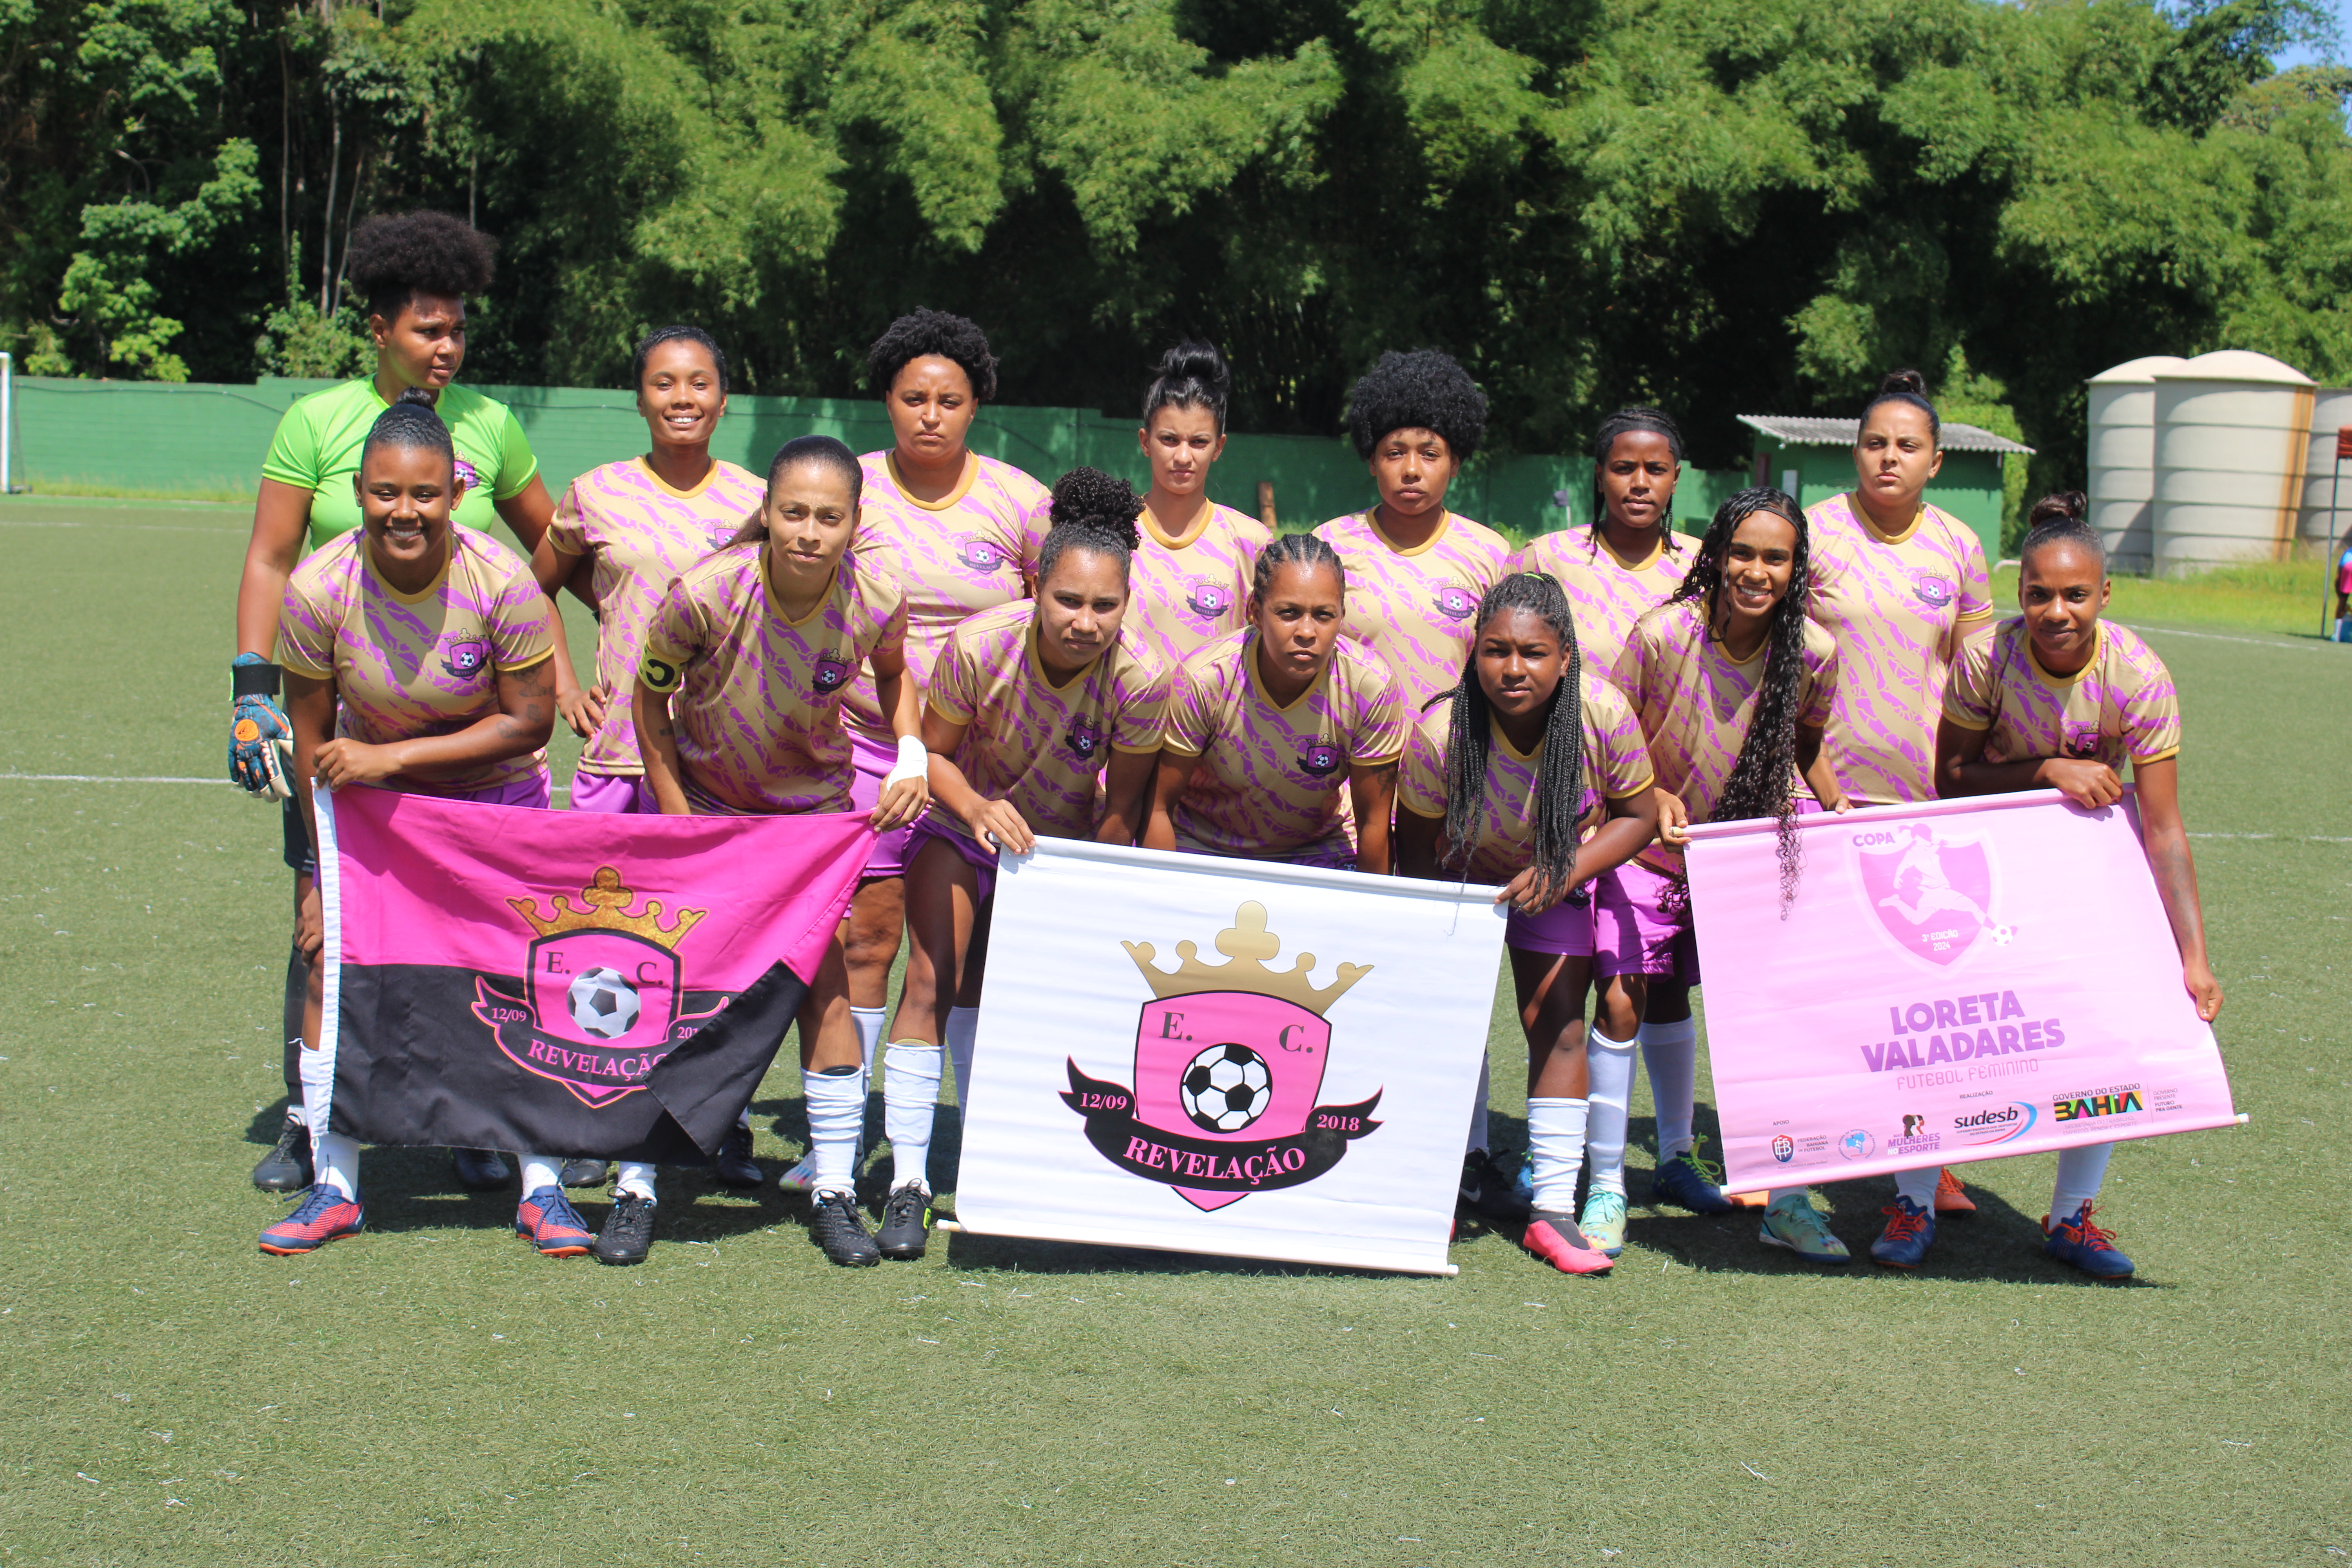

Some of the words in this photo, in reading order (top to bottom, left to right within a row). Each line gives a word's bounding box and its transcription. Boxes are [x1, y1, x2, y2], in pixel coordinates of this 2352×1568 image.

[1852, 831, 1895, 847] COPA
[1933, 941, 1951, 951] 2024
[546, 951, 570, 975] E.
[636, 962, 664, 985] C.
[491, 1007, 526, 1022] 12/09
[1889, 990, 2025, 1035] LORETA
[1159, 1011, 1192, 1041] E.
[1279, 1024, 1313, 1053] C.
[1860, 1018, 2065, 1072] VALADARES
[1897, 1069, 1964, 1090] FUTEBOL
[1968, 1058, 2039, 1081] FEMININO
[1960, 1090, 1993, 1099] REALIZAÇÃO
[2053, 1089, 2093, 1101] GOVERNO
[2109, 1082, 2140, 1093] ESTADO
[1080, 1093, 1127, 1110] 12/09
[2054, 1092, 2143, 1122] BAHIA
[1316, 1114, 1359, 1131] 2018
[1954, 1106, 2018, 1129] sudesb
[1797, 1134, 1827, 1143] FEDERAÇÃO
[1888, 1132, 1940, 1147] MULHERES
[1898, 1142, 1940, 1154] ESPORTE
[1123, 1136, 1305, 1185] REVELAÇÃO
